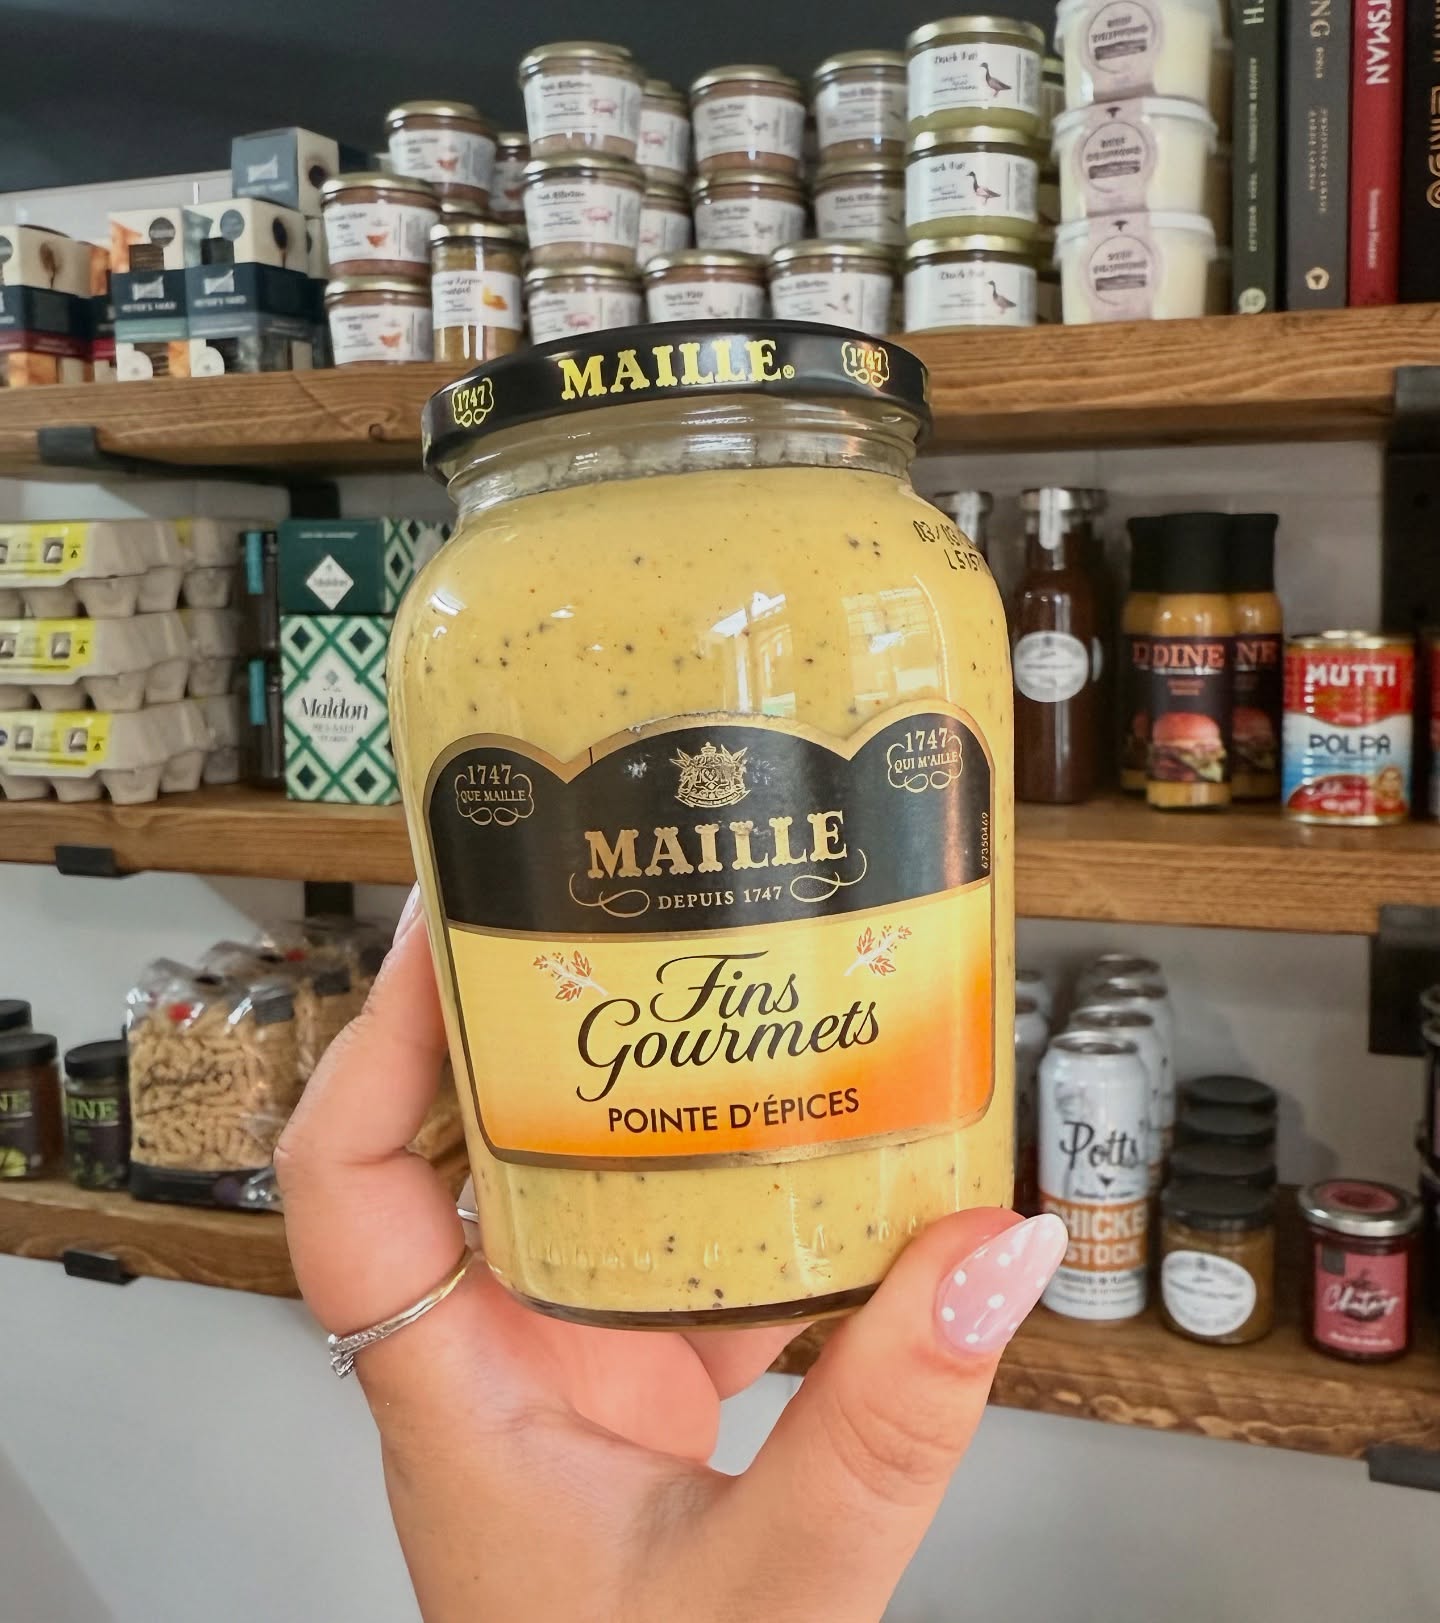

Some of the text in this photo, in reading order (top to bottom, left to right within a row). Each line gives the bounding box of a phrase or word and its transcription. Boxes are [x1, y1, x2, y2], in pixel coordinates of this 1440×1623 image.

[851, 346, 882, 372] 1747
[457, 385, 486, 412] 1747
[1152, 643, 1226, 669] DINE
[1305, 663, 1396, 687] MUTTI
[301, 696, 369, 720] Maldon
[905, 727, 949, 752] 1747
[1309, 733, 1391, 755] POLPA
[894, 751, 959, 773] QUI M'AILLE
[467, 764, 512, 786] 1747
[460, 789, 527, 804] QUE MAILLE
[584, 810, 848, 879] MAILLE
[657, 885, 783, 910] DEPUIS 1747
[649, 950, 800, 1023] Fins
[576, 998, 880, 1102] Gourmets
[608, 1087, 860, 1134] POINTE D'ÉPICES
